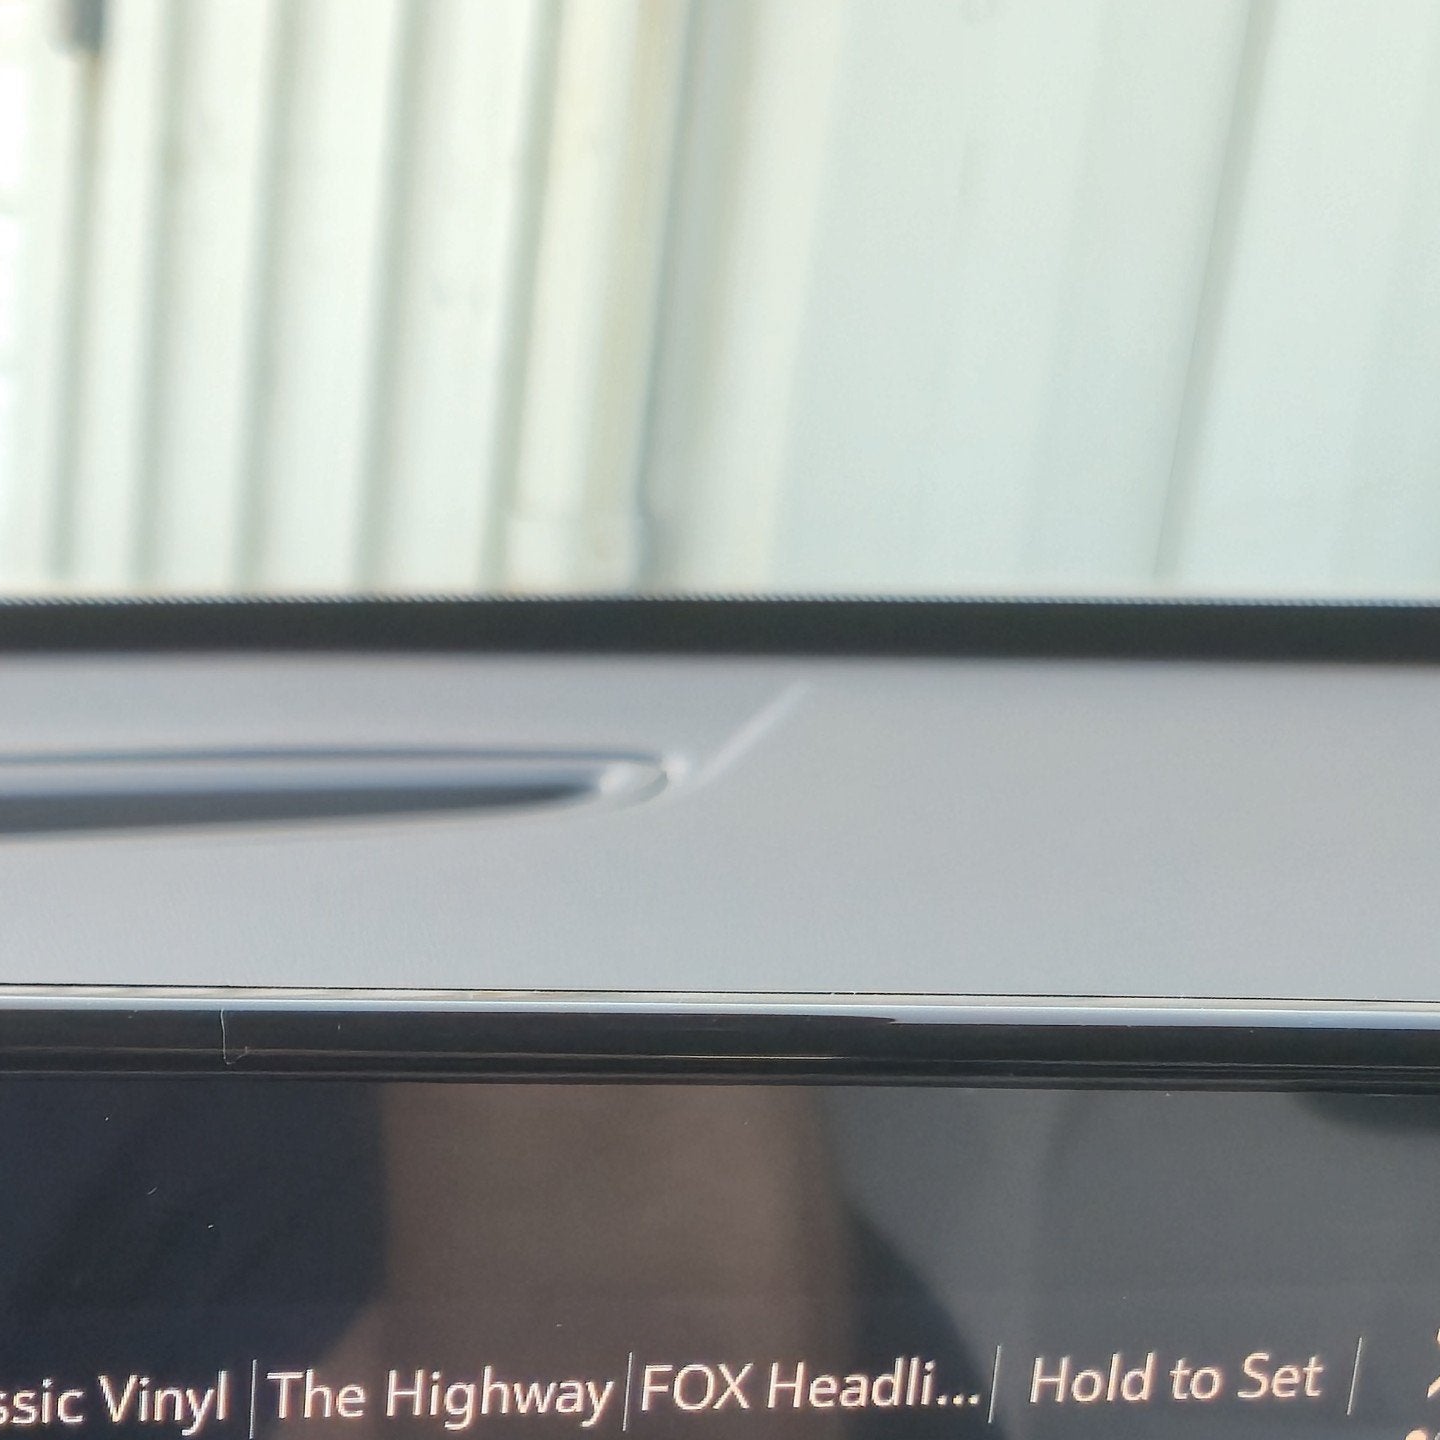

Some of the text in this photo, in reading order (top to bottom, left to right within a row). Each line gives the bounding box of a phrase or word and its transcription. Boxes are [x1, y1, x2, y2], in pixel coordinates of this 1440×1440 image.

[97, 1369, 229, 1438] Vinyl
[266, 1364, 616, 1432] The Highway
[640, 1361, 754, 1413] FOX
[1029, 1350, 1325, 1404] Hold to Set
